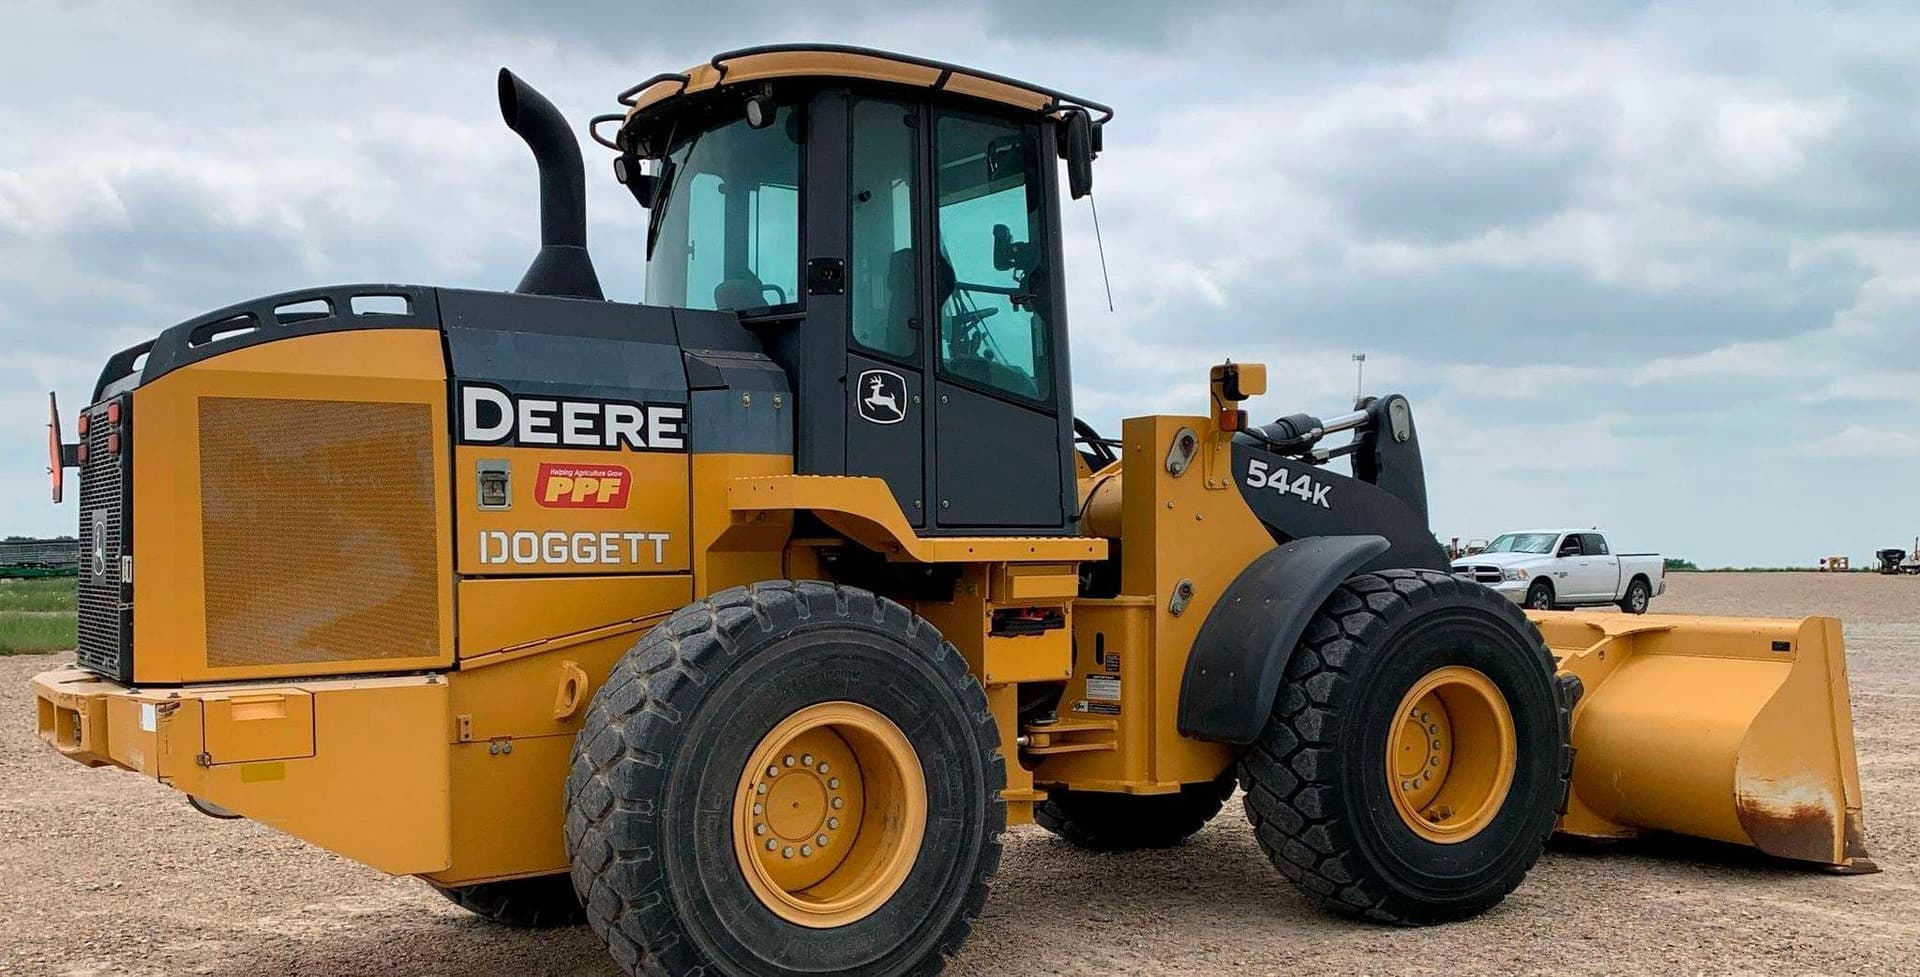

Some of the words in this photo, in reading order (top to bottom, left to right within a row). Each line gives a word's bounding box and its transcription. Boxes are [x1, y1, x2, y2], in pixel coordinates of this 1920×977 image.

[463, 386, 684, 449] DEERE
[544, 476, 622, 503] PPF
[550, 468, 573, 477] Helping
[574, 469, 606, 478] Agriculture
[1246, 459, 1333, 509] 544K
[480, 531, 670, 564] DOGGETT
